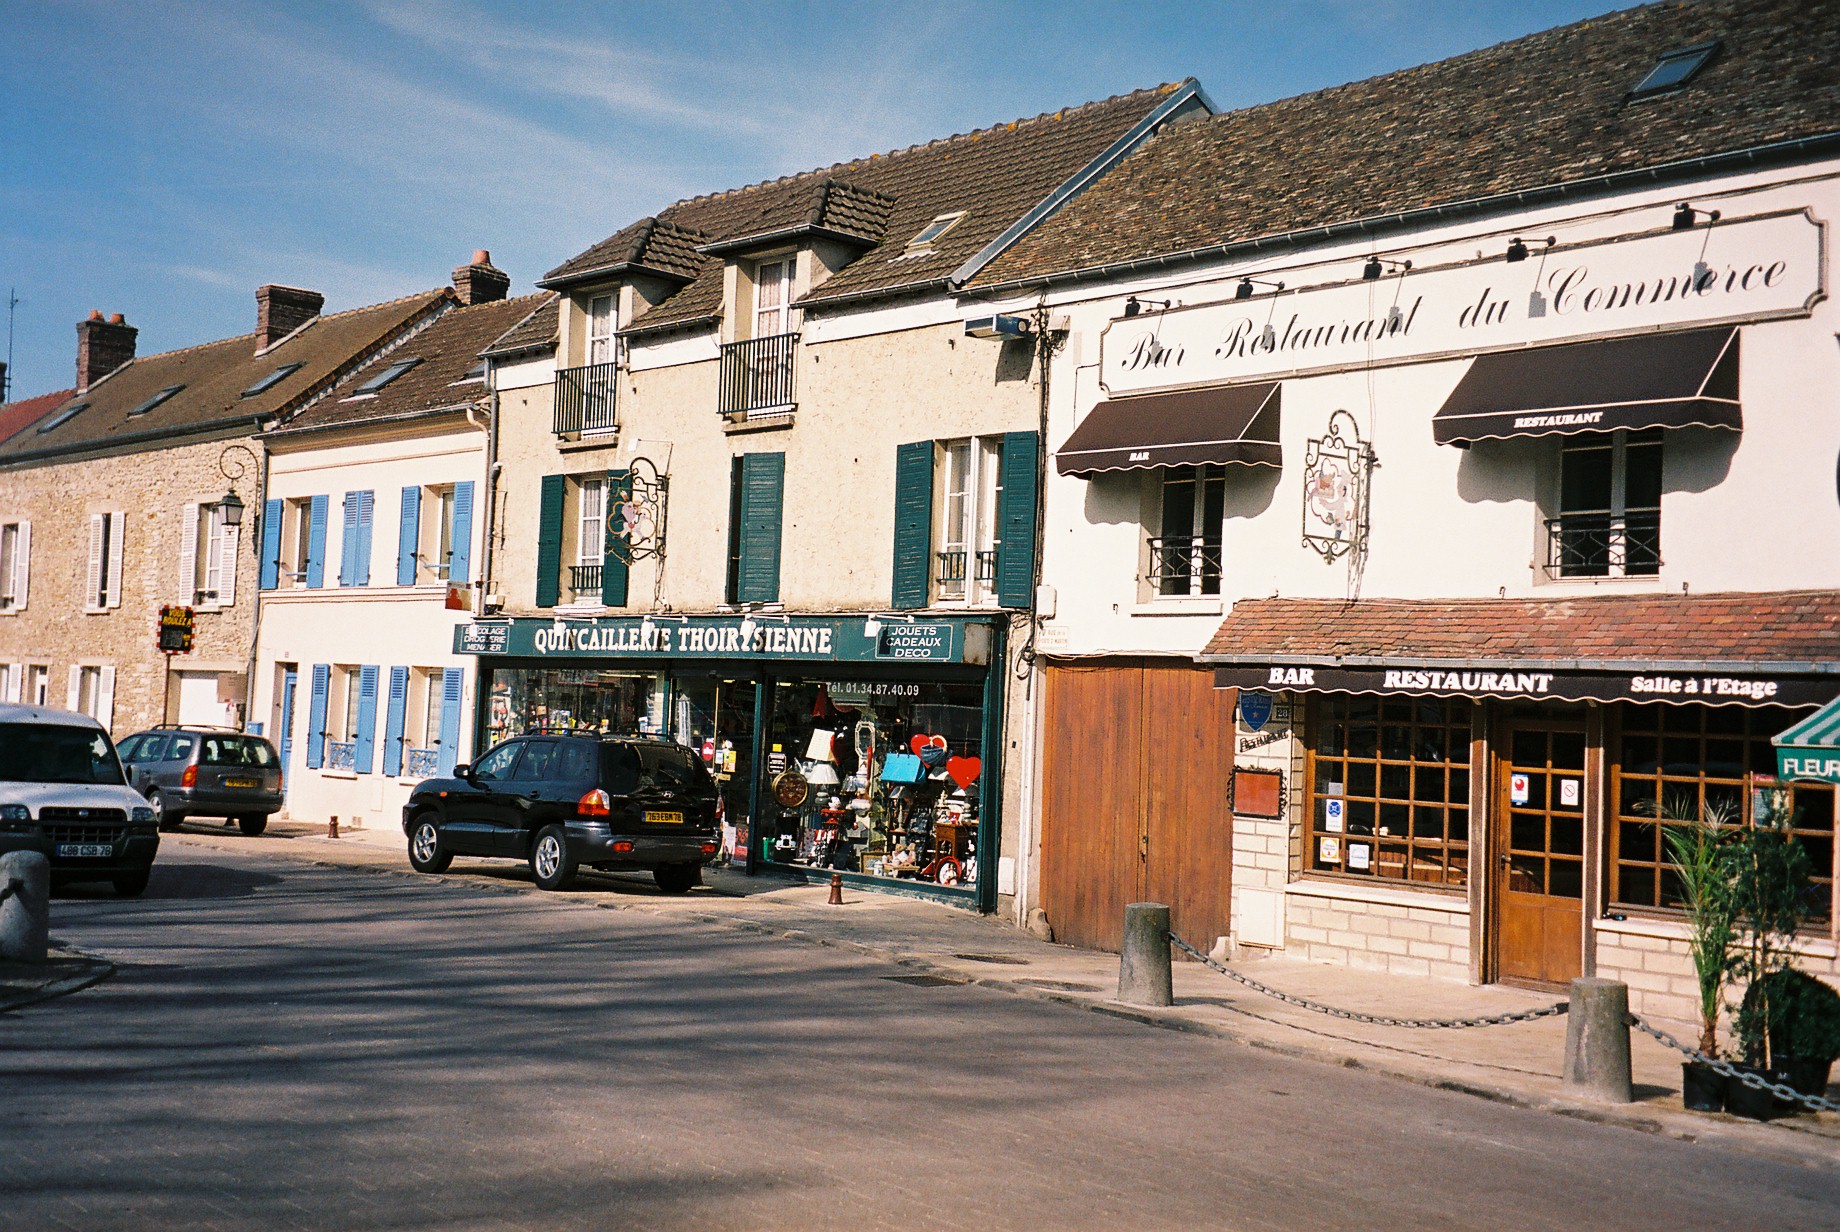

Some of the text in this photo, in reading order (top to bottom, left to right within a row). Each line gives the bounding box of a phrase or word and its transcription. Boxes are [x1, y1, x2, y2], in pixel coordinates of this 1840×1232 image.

[1121, 260, 1786, 371] Bar Restaurant du Commerce
[1513, 412, 1604, 428] RESTAURANT
[1128, 451, 1150, 462] BAR
[465, 627, 506, 635] BCOLAGE
[891, 627, 937, 636] JOUETS
[534, 627, 833, 654] QUINCAILLERIE THOIRYSIENNE
[886, 637, 942, 647] CADEAUX
[894, 648, 932, 657] DECO
[825, 682, 919, 696] Tél. 01.34.87.40.09
[1268, 667, 1315, 685] BAR
[1383, 670, 1554, 692] RESTAURANT
[1630, 676, 1682, 693] Salle
[1702, 677, 1778, 699] l'Etage
[1783, 758, 1840, 777] FLEUR
